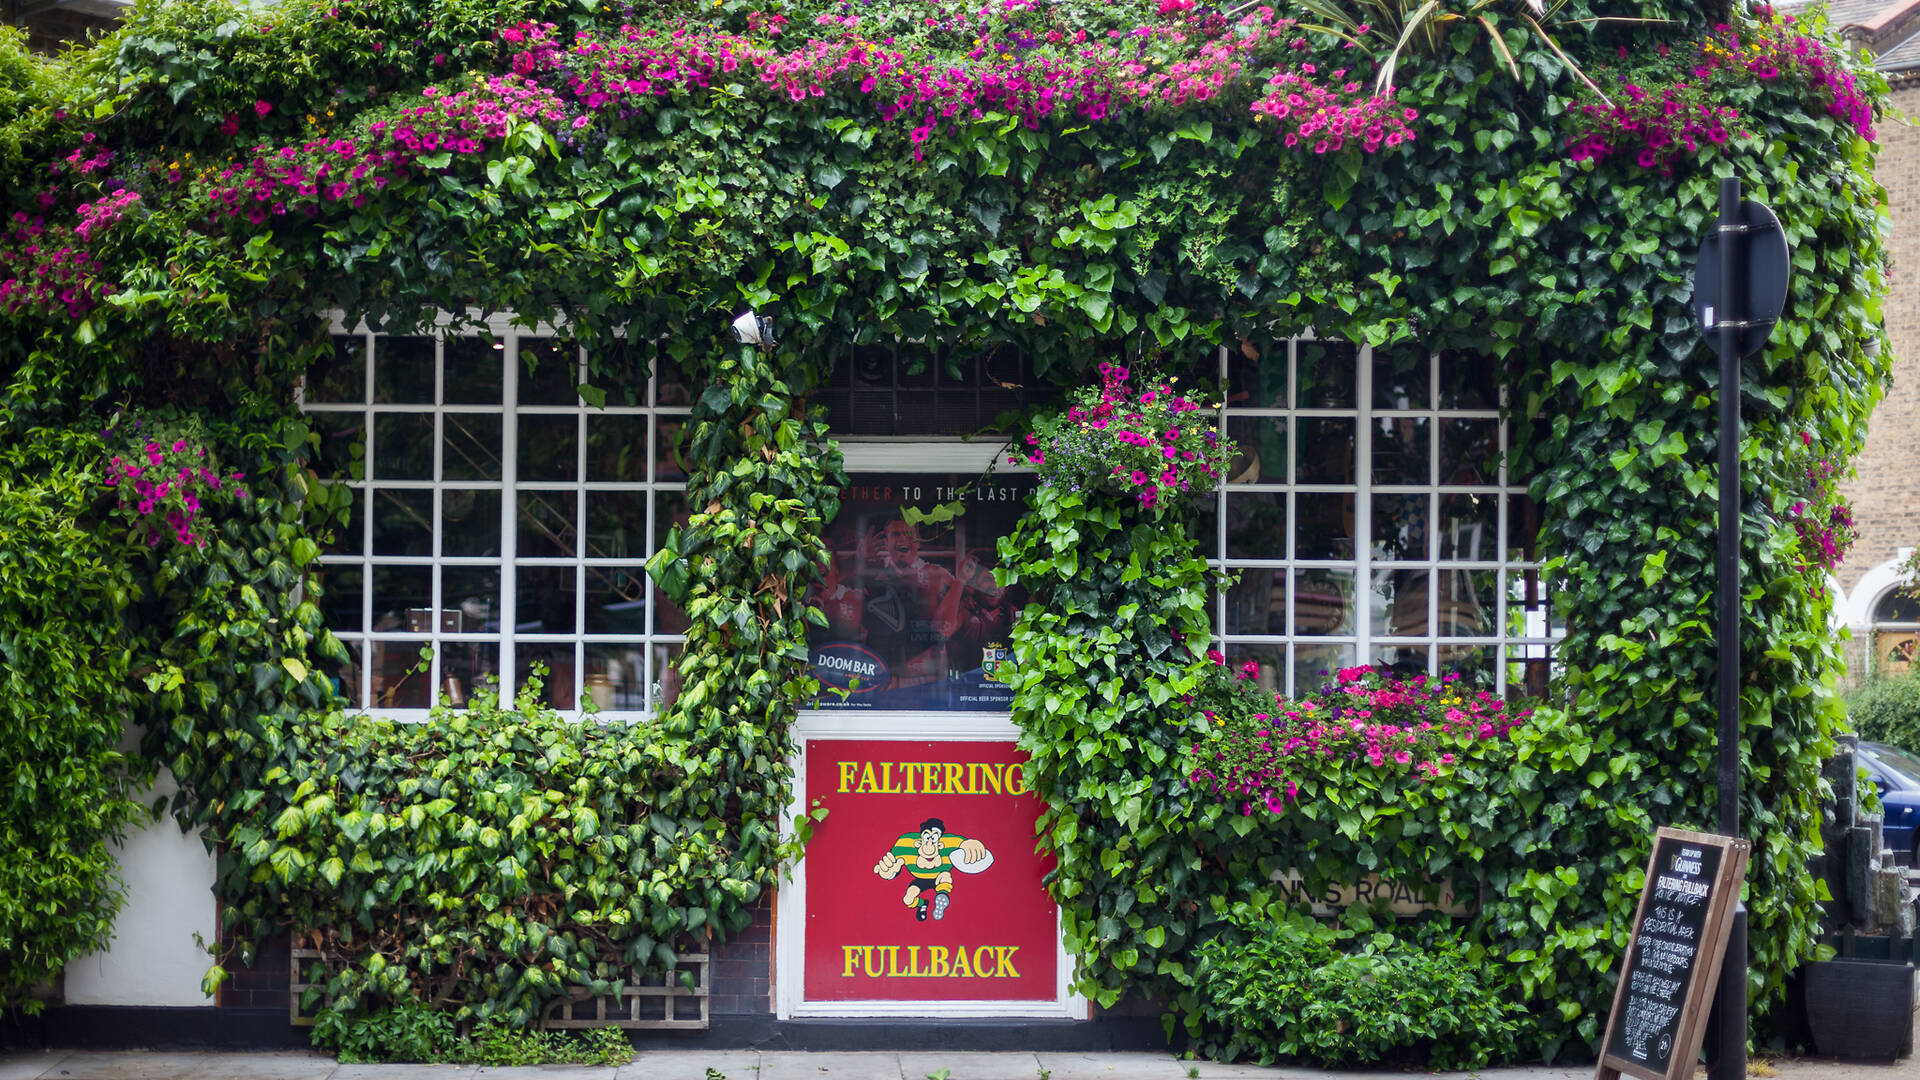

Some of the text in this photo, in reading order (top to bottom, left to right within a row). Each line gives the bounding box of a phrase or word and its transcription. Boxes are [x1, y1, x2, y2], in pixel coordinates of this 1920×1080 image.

[841, 487, 892, 500] ETHER
[903, 487, 921, 500] TO
[977, 487, 1017, 501] LAST
[818, 654, 876, 676] DOOM BAR
[836, 761, 1027, 796] FALTERING
[1674, 856, 1703, 875] GUINNESS
[1268, 879, 1342, 904] NNS
[1657, 875, 1709, 898] FALTERING FULLBACK
[841, 945, 1021, 978] FULLBACK
